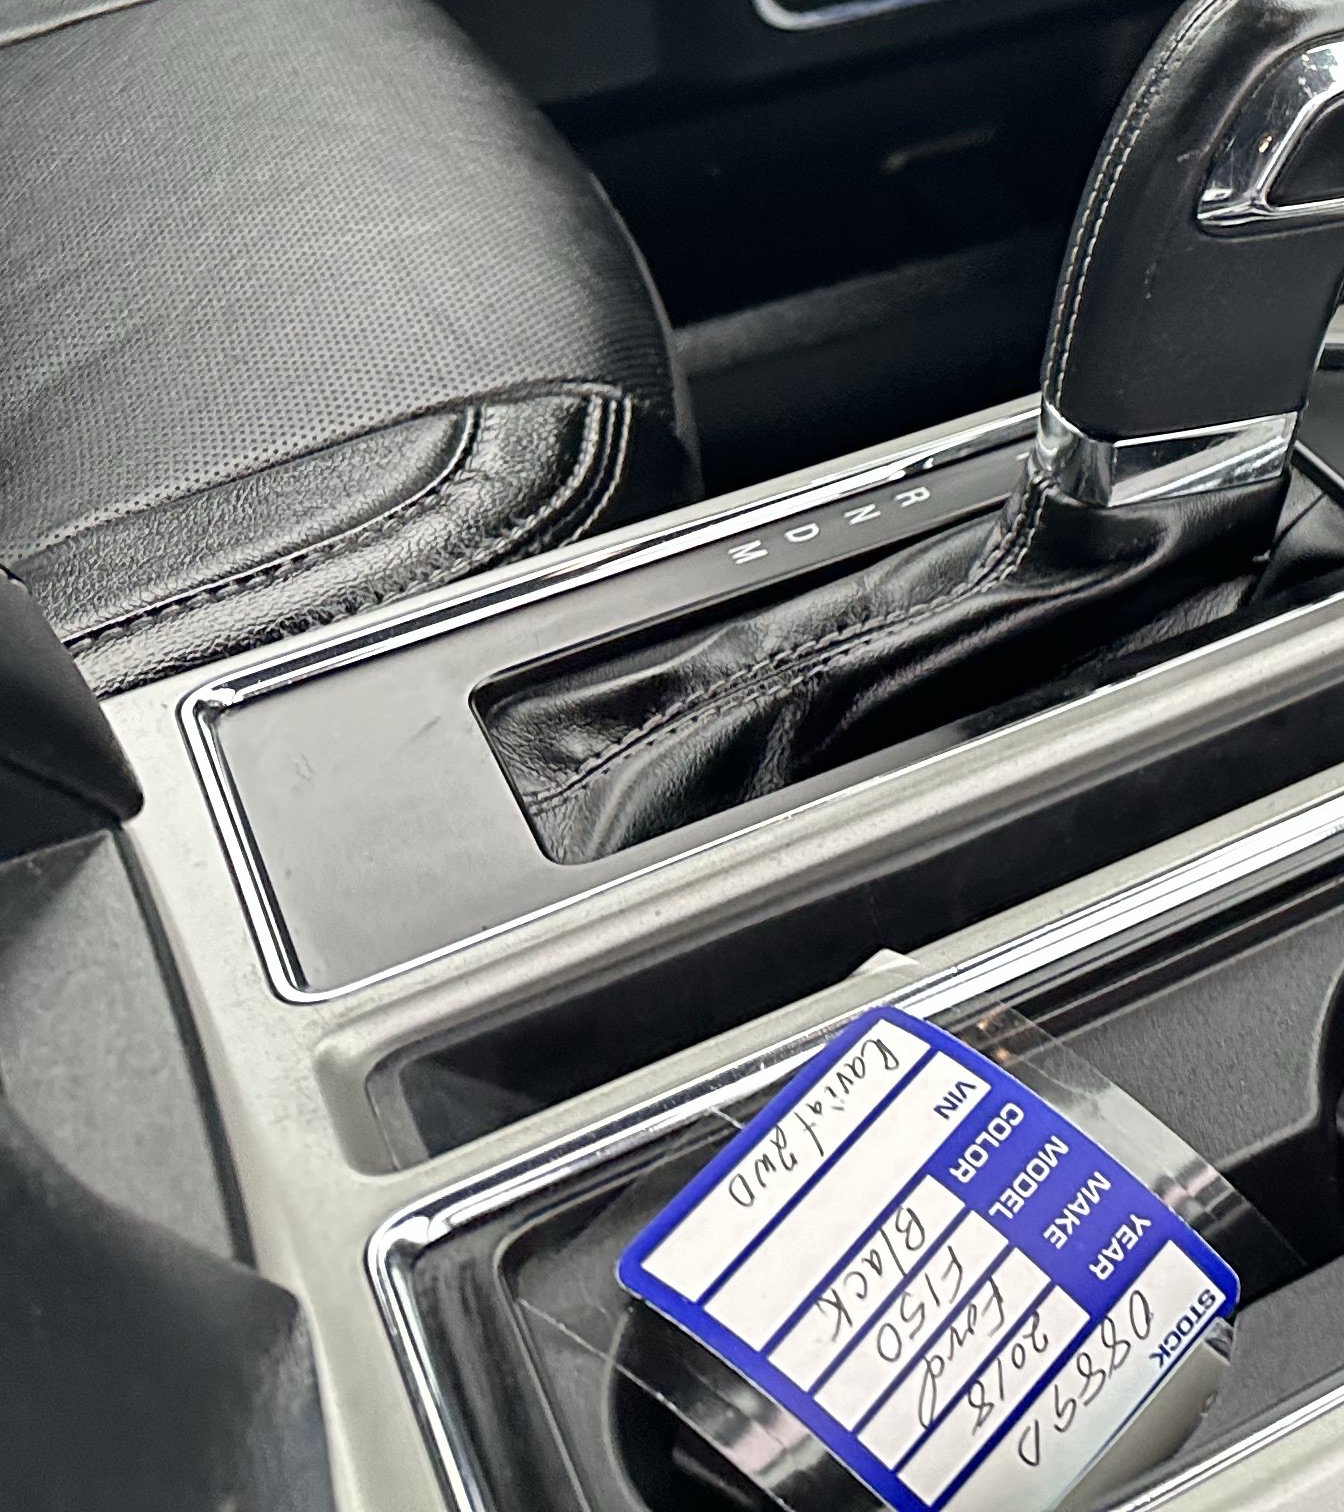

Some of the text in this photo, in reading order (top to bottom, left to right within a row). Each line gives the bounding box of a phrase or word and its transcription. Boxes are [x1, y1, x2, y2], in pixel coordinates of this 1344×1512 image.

[784, 522, 819, 544] D
[844, 503, 880, 526] N
[893, 487, 931, 511] R
[729, 540, 769, 566] M
[933, 1080, 977, 1119] VIN
[949, 1102, 1023, 1184] COLOR
[988, 1135, 1069, 1220] MODEL
[1043, 1171, 1112, 1250] MAKE
[1088, 1214, 1152, 1281] YEAR
[815, 1206, 925, 1342] Black
[876, 1245, 963, 1362] F150
[918, 1276, 1005, 1432] Ford
[1149, 1288, 1217, 1369] STOCK
[967, 1313, 1048, 1435] 2018
